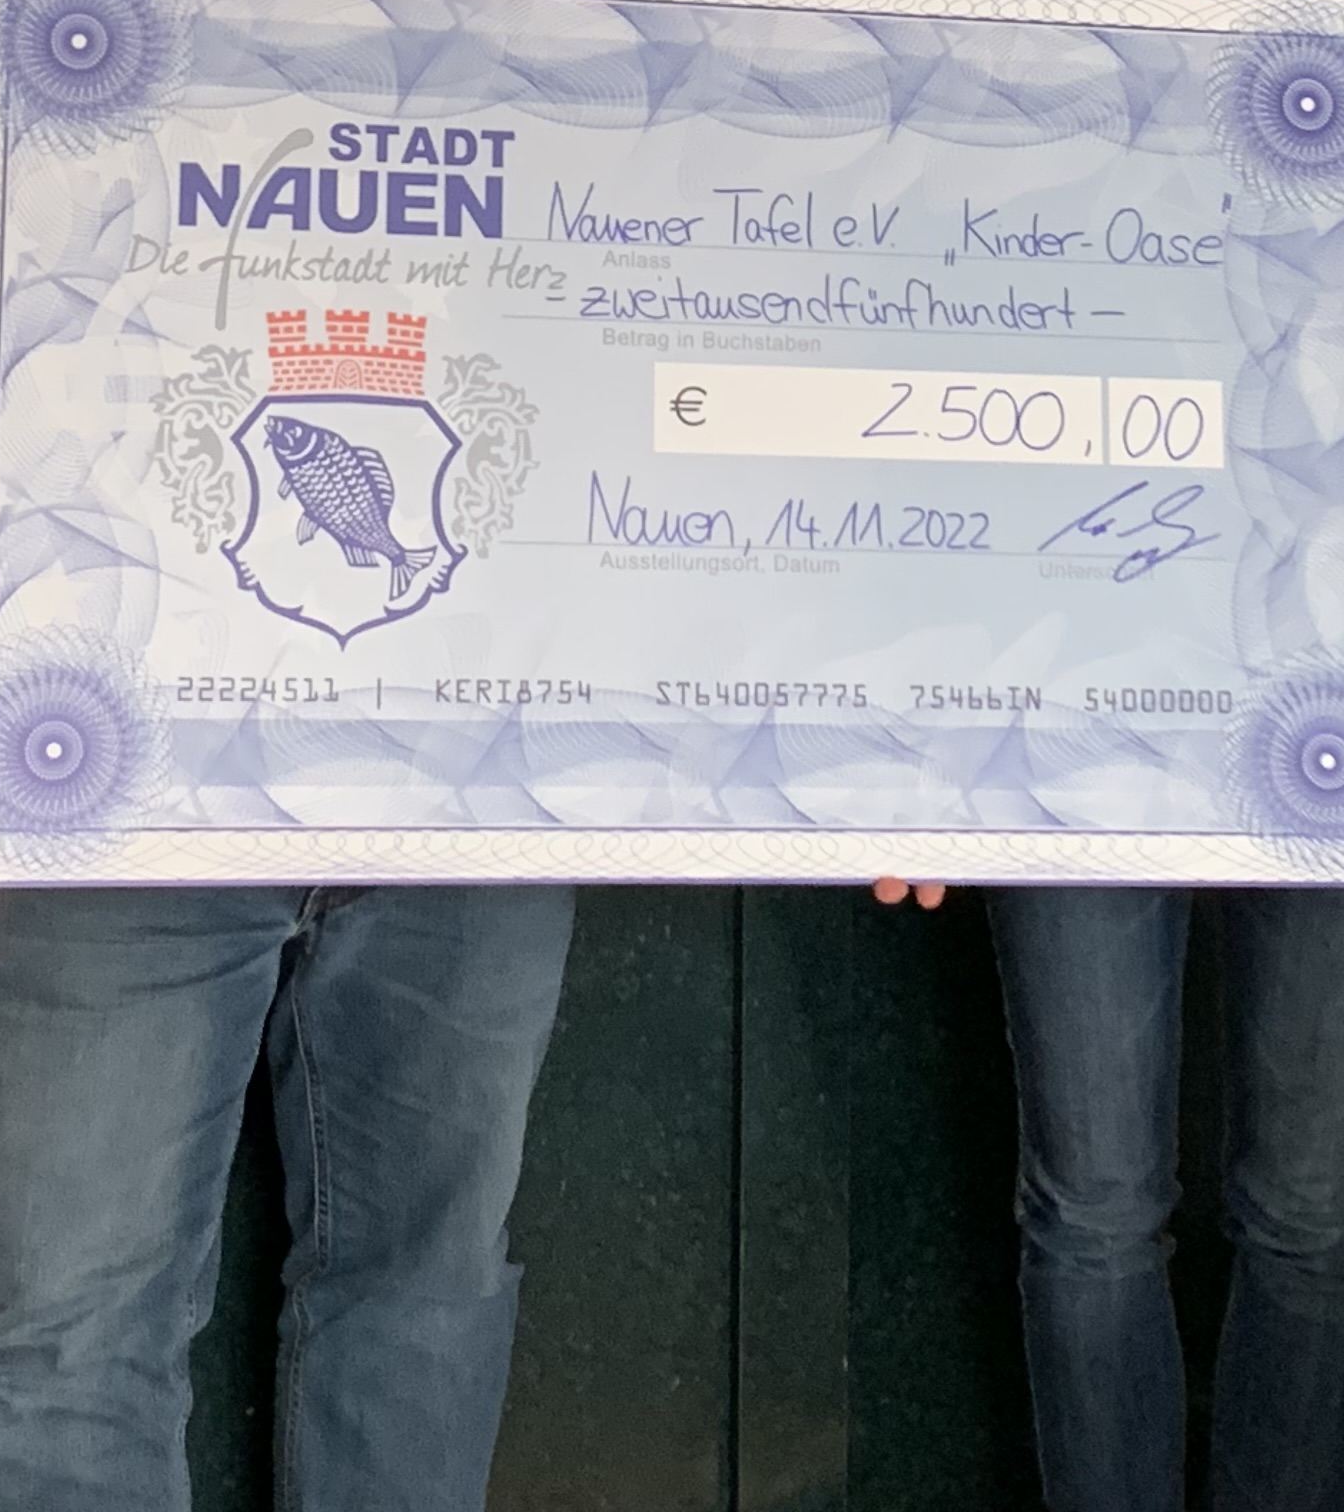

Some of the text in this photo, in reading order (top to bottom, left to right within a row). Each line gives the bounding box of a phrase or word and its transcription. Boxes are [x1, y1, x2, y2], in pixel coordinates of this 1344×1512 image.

[328, 122, 515, 168] STADT
[177, 161, 504, 240] NAUEN
[546, 180, 704, 246] Nauener
[712, 187, 814, 249] Tafel
[125, 234, 188, 277] Die
[406, 251, 470, 289] mit
[488, 244, 568, 292] Herz
[601, 250, 672, 270] Anlass
[602, 327, 822, 354] Betrag in Buchstaben
[669, 385, 708, 427] €
[764, 498, 992, 552] 14.11.2022
[599, 550, 842, 575] Ausstellungsort, Datum
[177, 677, 340, 703] 22224511
